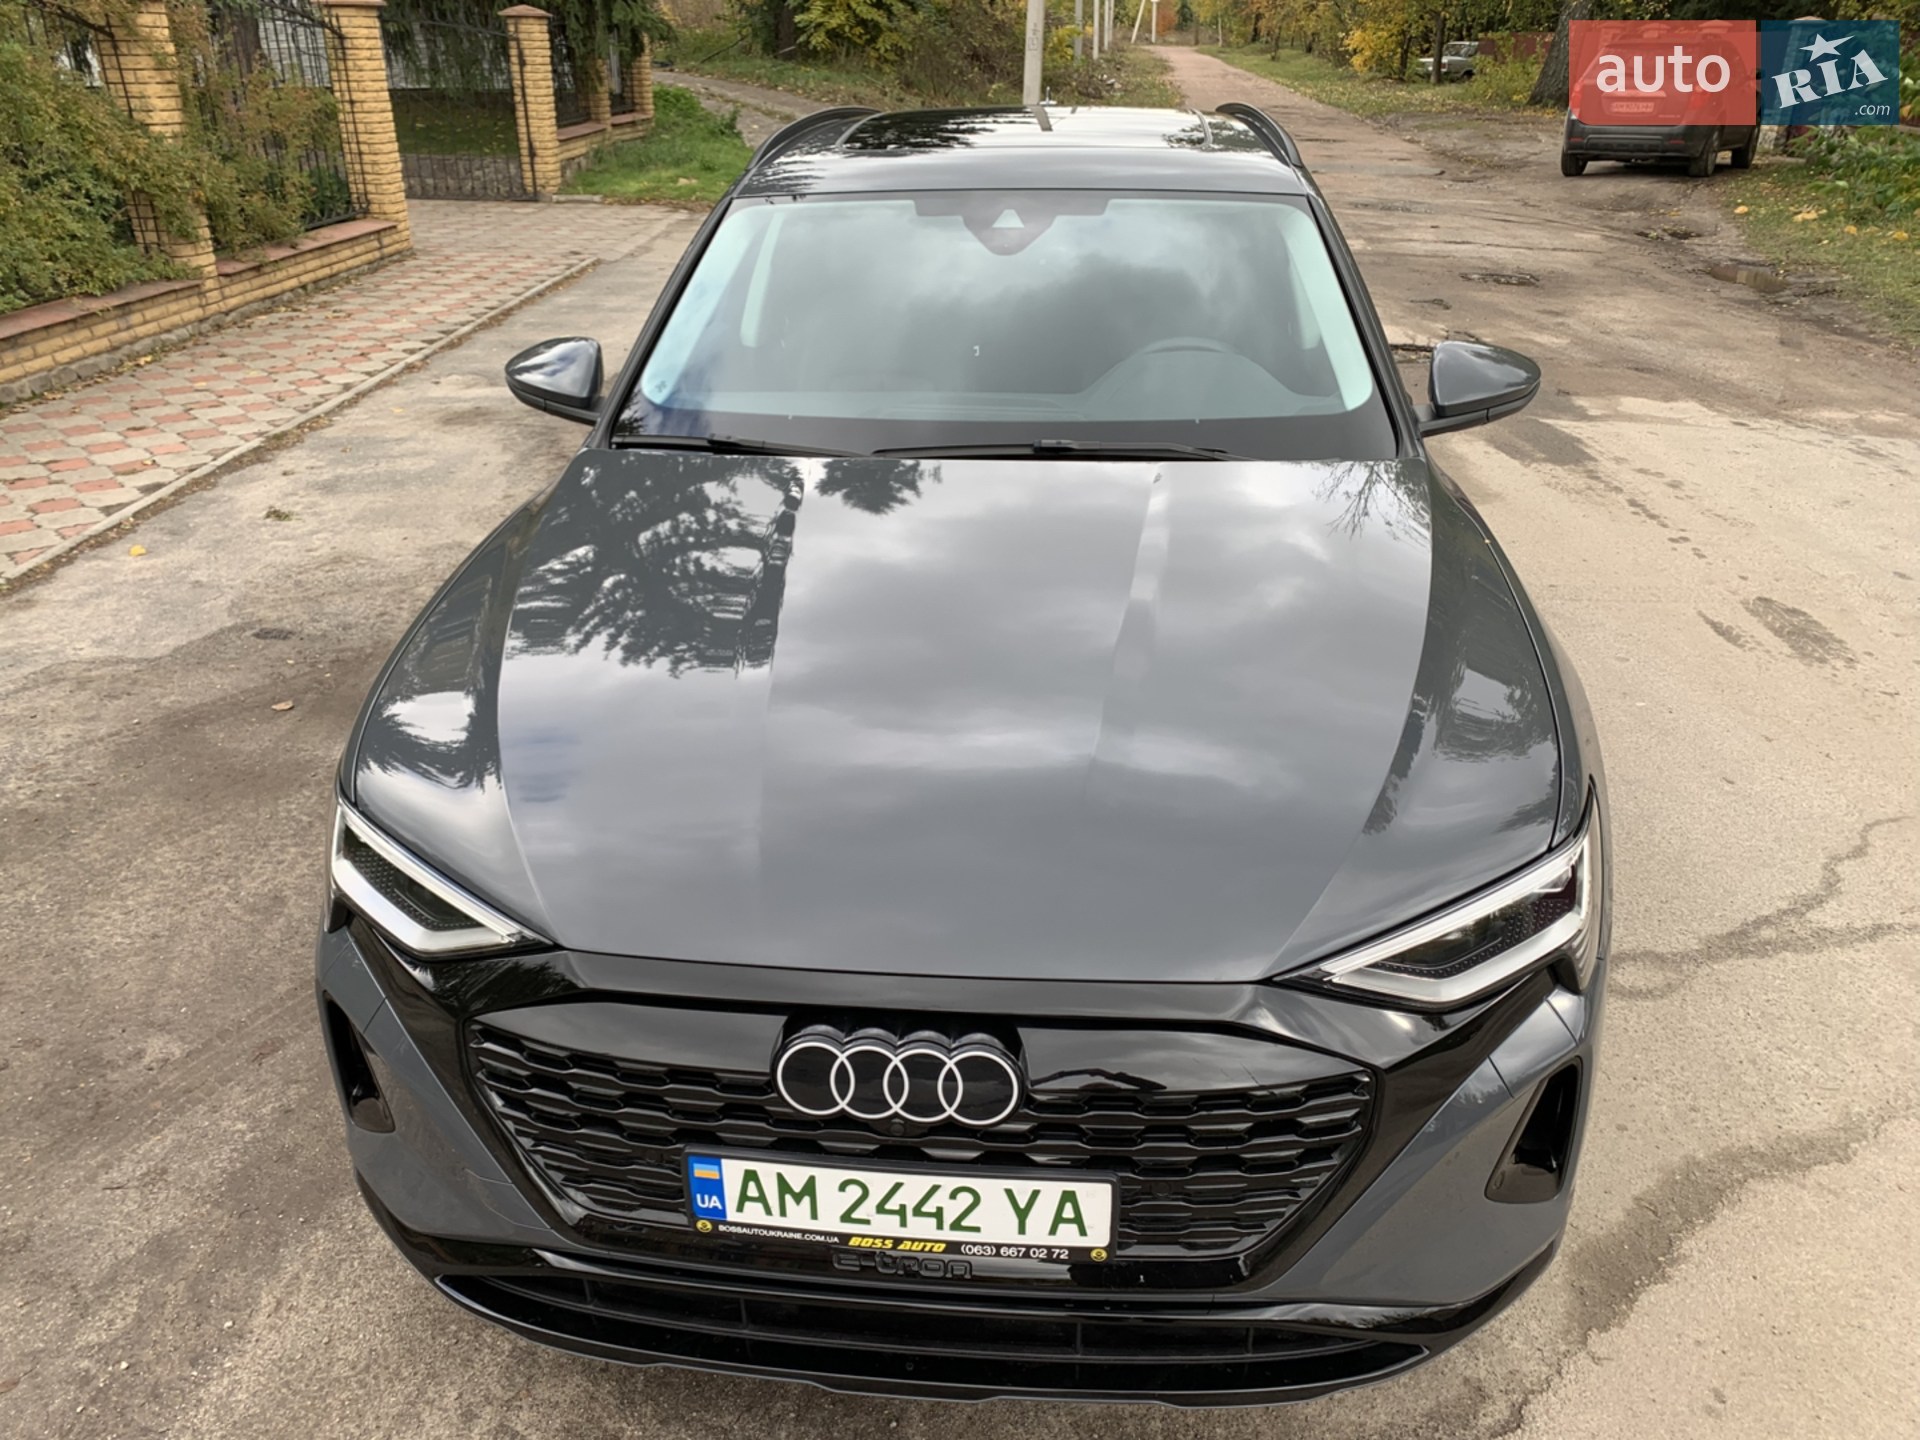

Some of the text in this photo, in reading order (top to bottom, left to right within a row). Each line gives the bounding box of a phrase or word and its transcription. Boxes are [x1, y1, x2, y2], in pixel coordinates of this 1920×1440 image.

[696, 1193, 723, 1210] UA
[736, 1168, 1088, 1237] AM 2442 YA
[718, 1224, 840, 1244] BOSSAUTOUKRAINE.COM.UA
[848, 1236, 946, 1253] BOSS AUTO
[960, 1244, 1069, 1260] (063) 667 02 72
